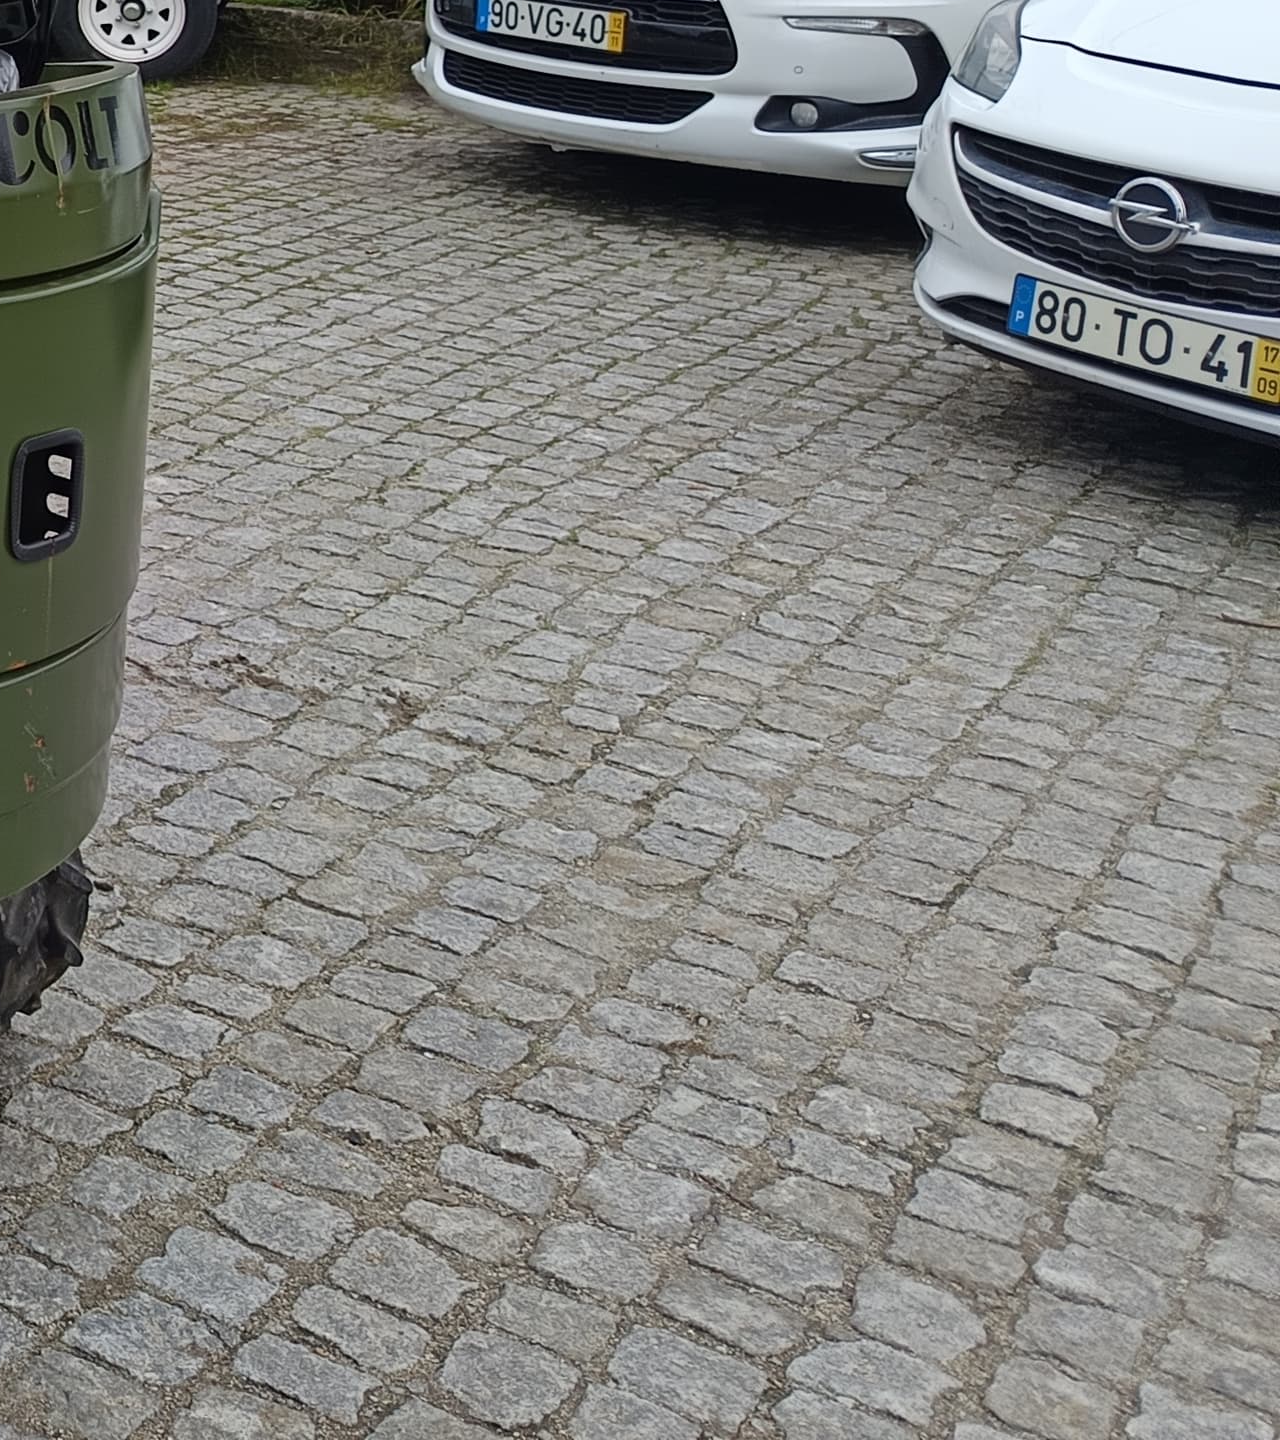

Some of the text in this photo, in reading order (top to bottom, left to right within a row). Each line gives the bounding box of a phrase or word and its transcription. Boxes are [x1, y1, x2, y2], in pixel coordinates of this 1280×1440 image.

[1015, 311, 1024, 322] P
[1264, 345, 1279, 364] 17
[1257, 376, 1278, 396] 09
